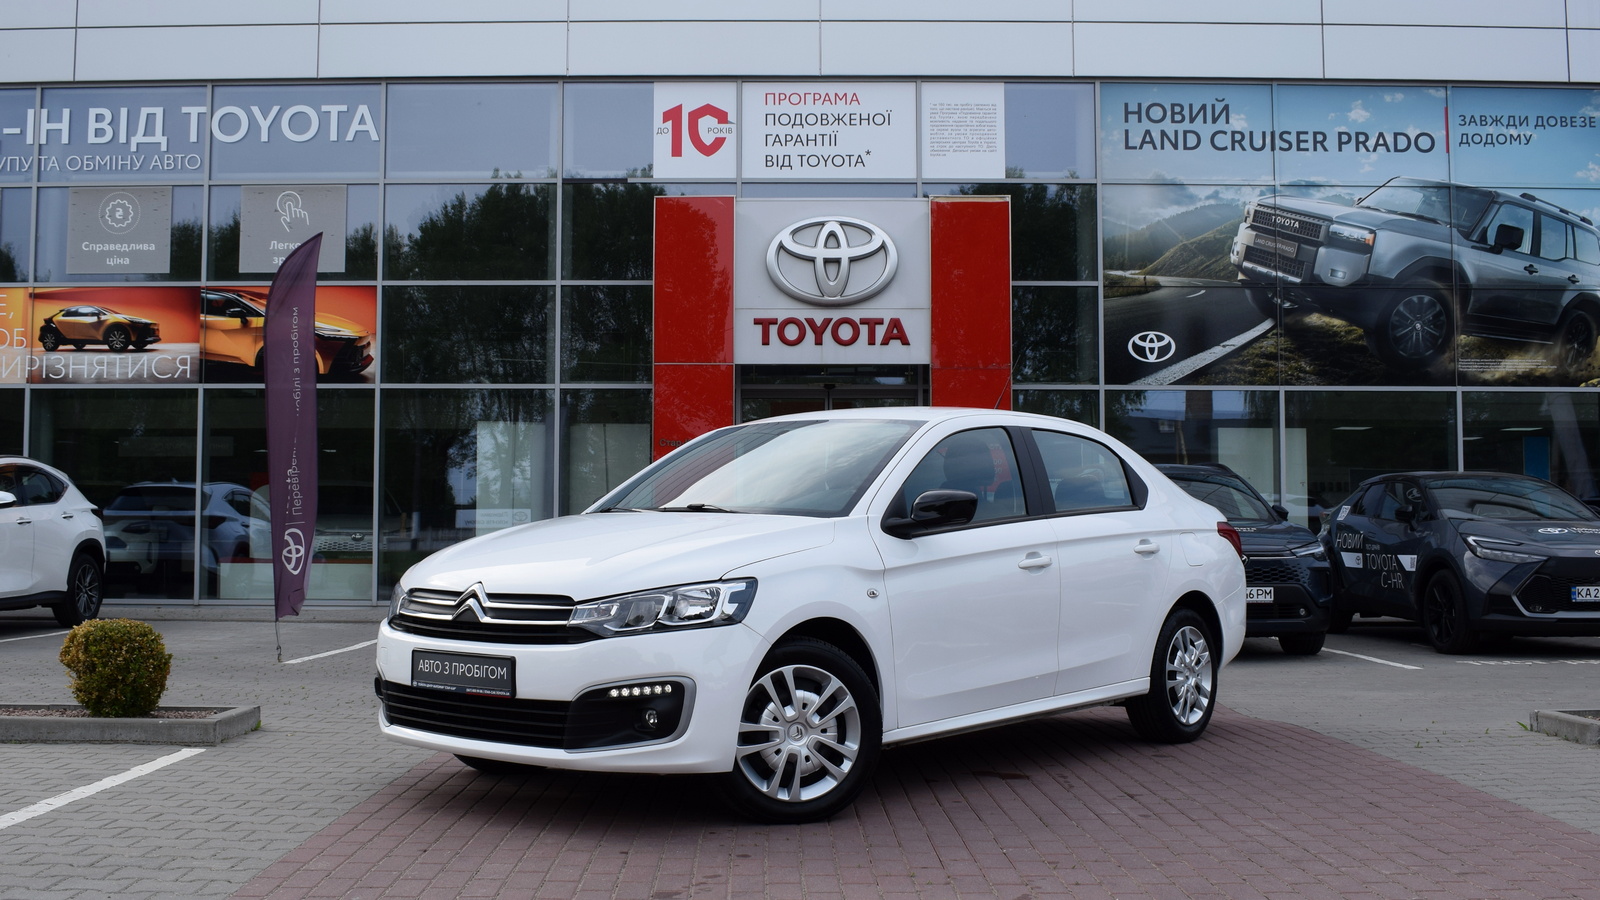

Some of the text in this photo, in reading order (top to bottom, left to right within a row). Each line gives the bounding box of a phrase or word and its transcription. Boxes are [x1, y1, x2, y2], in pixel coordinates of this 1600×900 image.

[765, 92, 861, 106] ПРОГРАМА
[765, 109, 893, 129] ПОДОВЖЕНОЇ
[1123, 98, 1230, 124] НОВИЙ
[87, 107, 168, 152] ВІД
[181, 103, 380, 143] TOYOTA
[1458, 114, 1597, 129] ЗАВЖДИ ДОВЕЗЕ
[656, 127, 670, 135] ДО
[765, 131, 839, 147] ГАРАНТІЇ
[1123, 129, 1436, 153] LAND CRUISER PRADO
[1458, 133, 1533, 148] ДОДОМУ
[38, 155, 60, 171] ТА
[65, 155, 145, 171] ОБМІНУ
[149, 154, 201, 170] АВТО
[765, 154, 793, 170] ВІД
[1271, 215, 1300, 229] TOYOTA
[81, 241, 156, 252] Справедлива
[106, 255, 130, 266] ціна
[753, 316, 911, 347] TOYOTA
[1335, 530, 1364, 549] НОВИЙ
[1365, 553, 1399, 570] TOYOTA
[1380, 571, 1404, 589] C-HR
[1256, 588, 1272, 599] PM
[1577, 588, 1592, 598] KA
[417, 659, 442, 674] АВТО
[451, 662, 507, 680] ПРОБІГОМ
